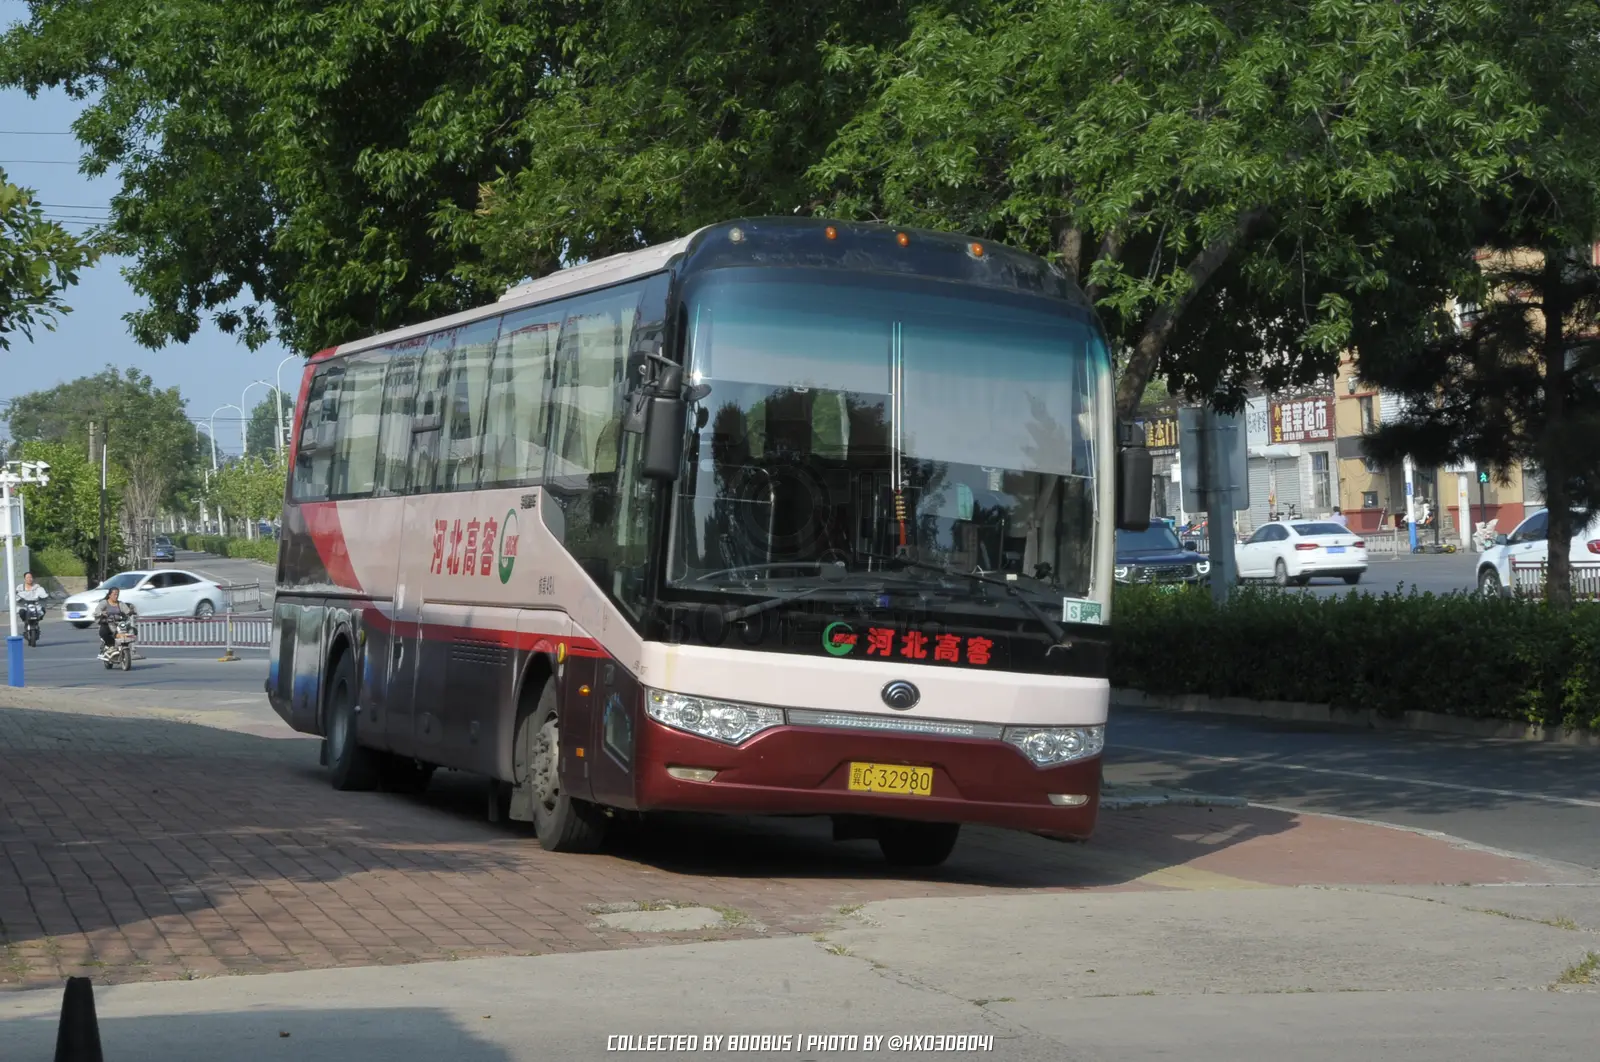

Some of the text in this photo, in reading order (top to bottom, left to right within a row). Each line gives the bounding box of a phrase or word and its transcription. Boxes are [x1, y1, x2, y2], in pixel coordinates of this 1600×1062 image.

[1281, 399, 1327, 432] 蔬菜超市
[430, 516, 498, 576] 河北高客
[866, 627, 994, 665] 河北高客
